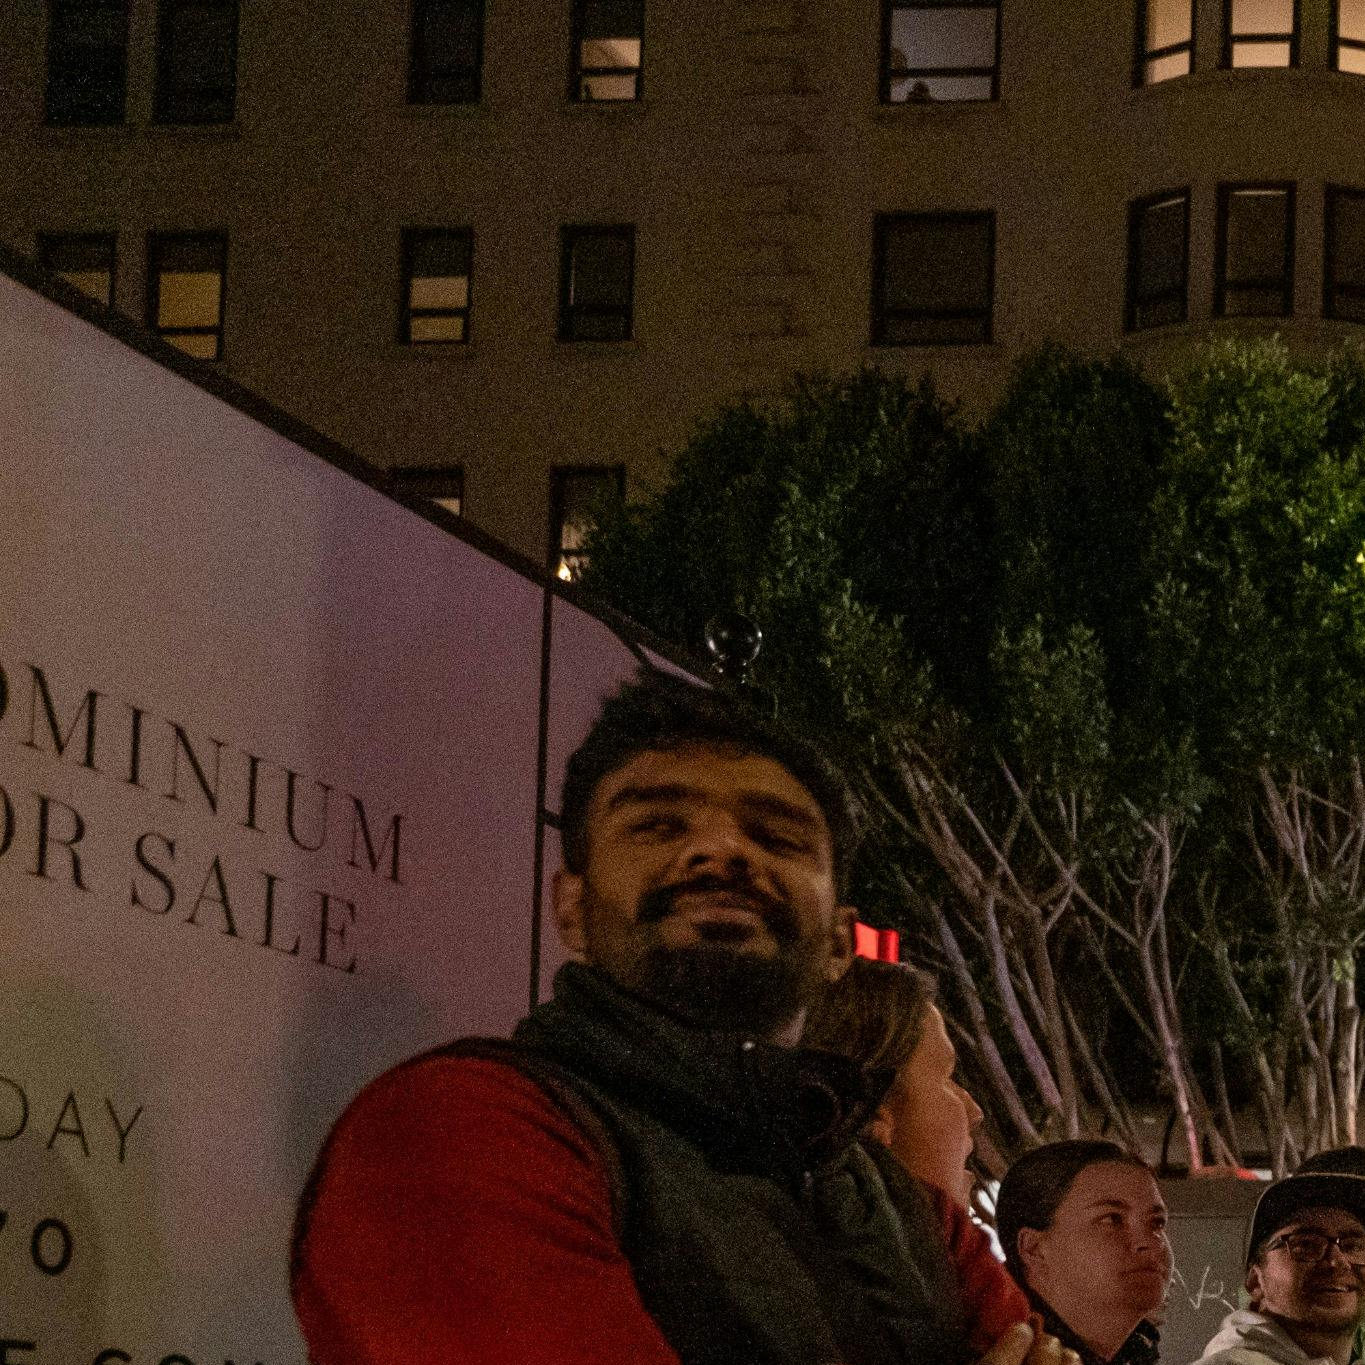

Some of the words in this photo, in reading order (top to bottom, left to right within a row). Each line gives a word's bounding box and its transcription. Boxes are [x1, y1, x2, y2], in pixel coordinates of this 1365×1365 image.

[0, 661, 407, 888] MINIUM
[0, 784, 94, 893] R
[130, 831, 360, 976] SALE
